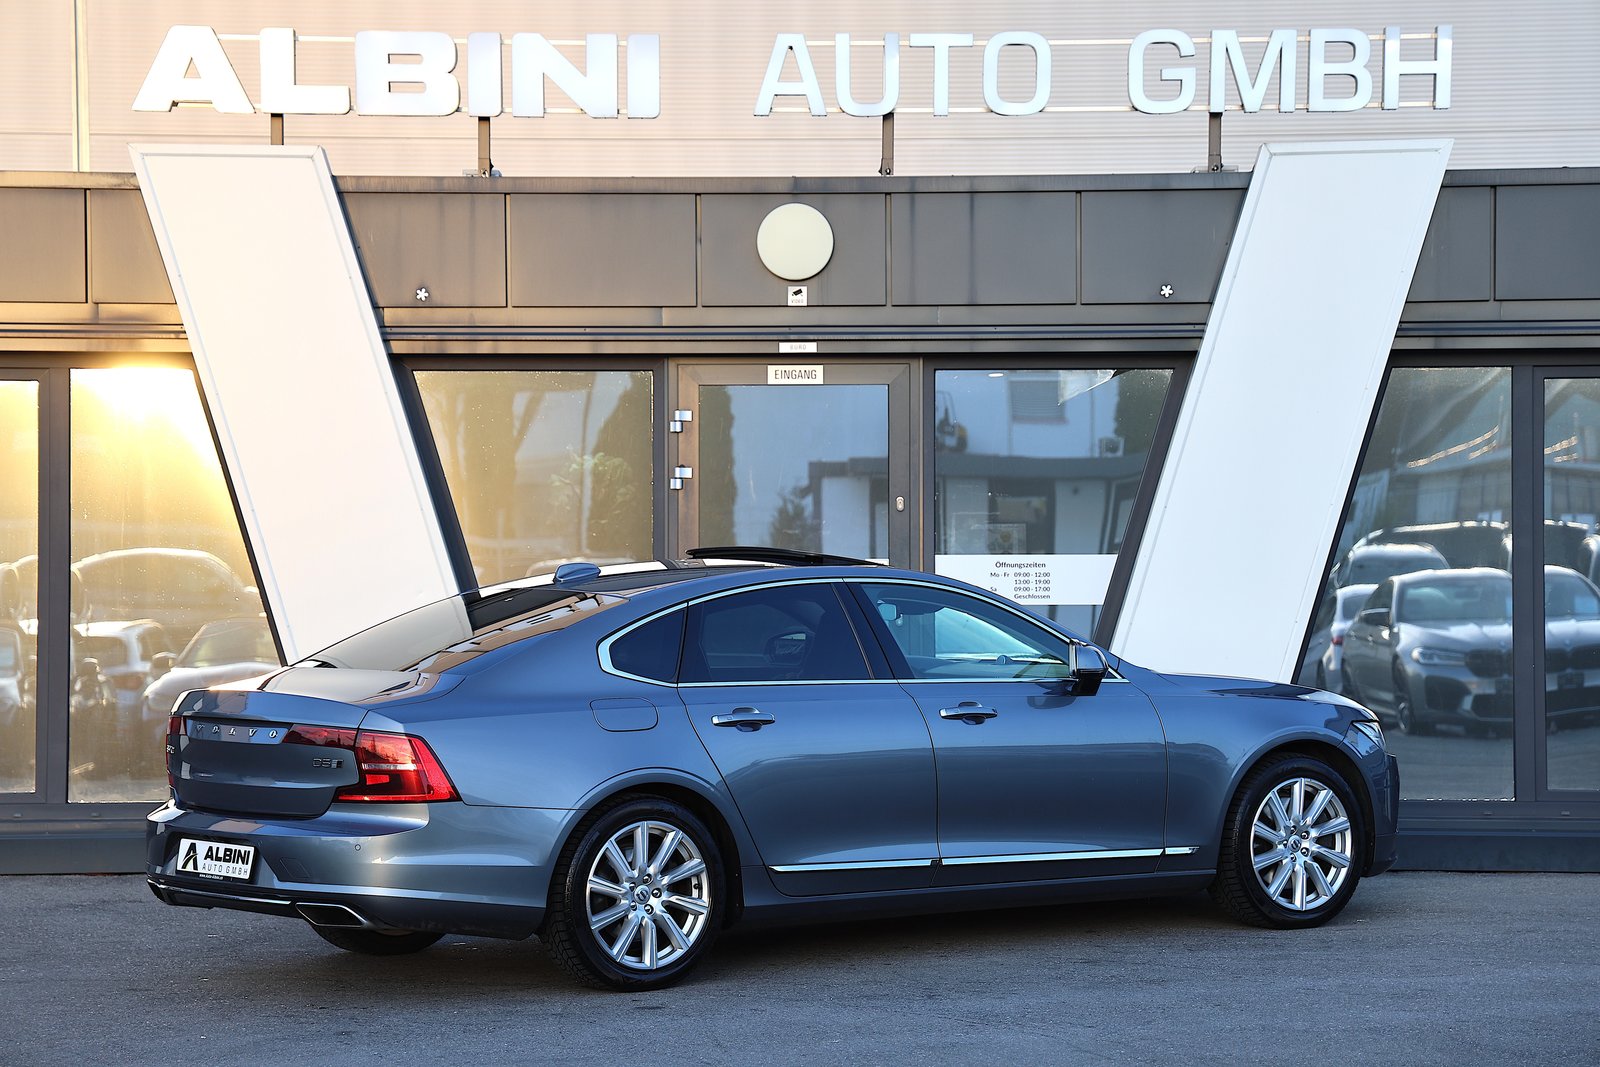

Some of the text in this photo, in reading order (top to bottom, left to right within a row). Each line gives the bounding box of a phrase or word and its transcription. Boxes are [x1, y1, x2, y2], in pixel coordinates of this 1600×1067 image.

[131, 24, 1453, 119] ALBINI AUTO GMBH
[774, 369, 817, 380] EINGANG
[995, 561, 1046, 569] Öffnungszeiten
[197, 724, 279, 739] VOLVO
[204, 846, 251, 865] ALBINI
[202, 863, 248, 876] AUTO GMBH
